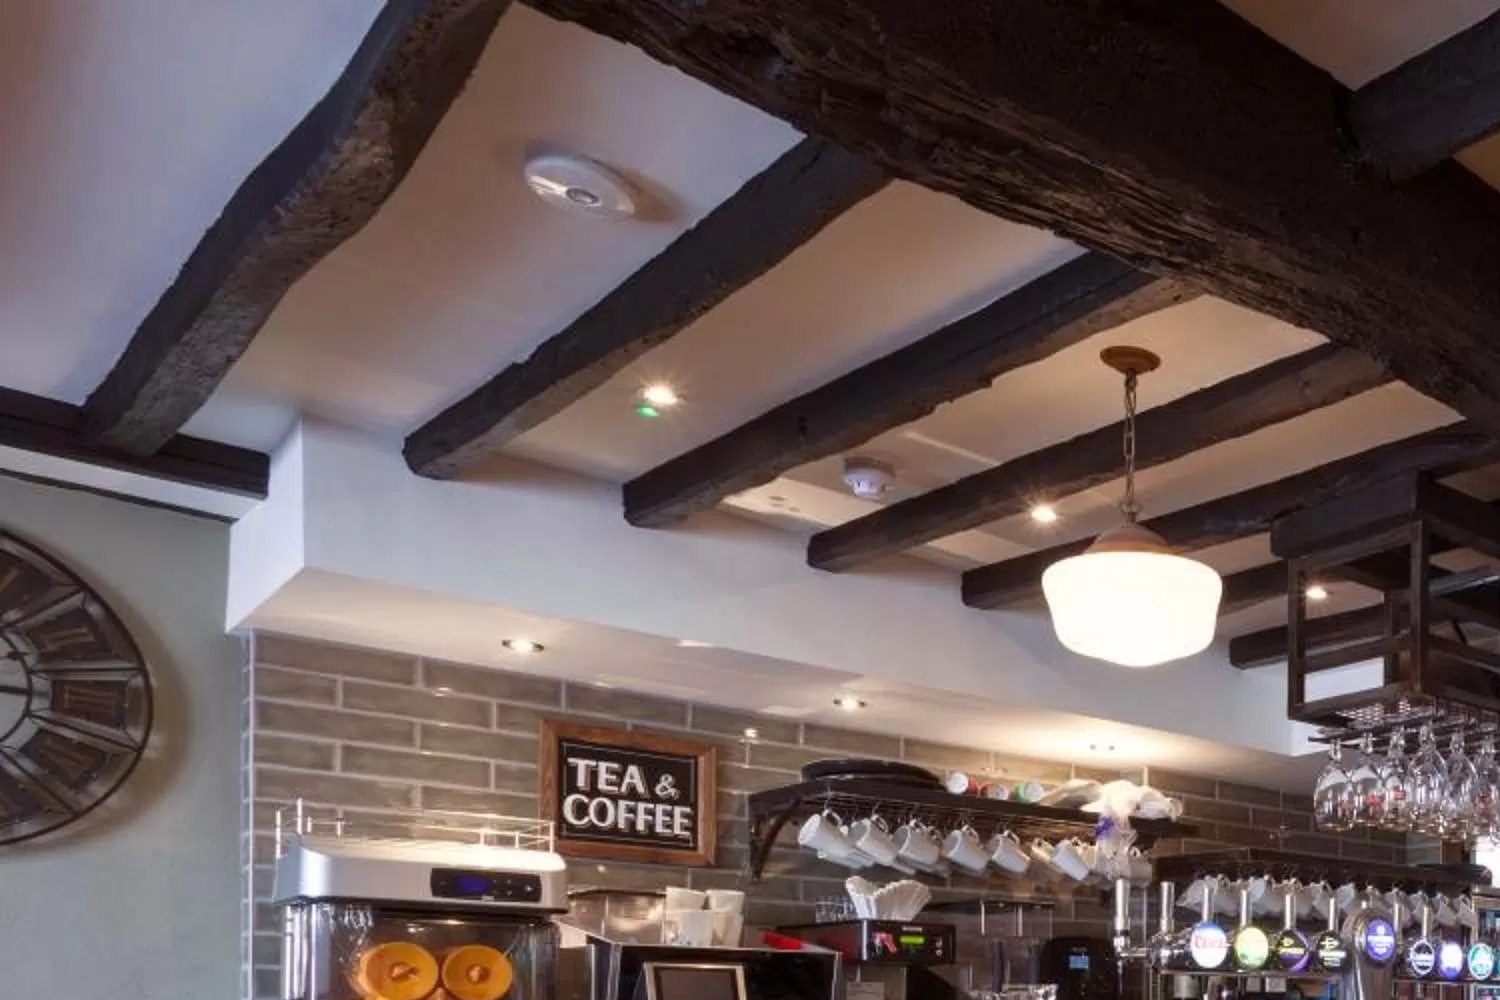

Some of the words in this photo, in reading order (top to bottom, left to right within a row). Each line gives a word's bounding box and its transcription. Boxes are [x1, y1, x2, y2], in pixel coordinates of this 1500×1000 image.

[567, 757, 649, 798] TEA
[654, 773, 679, 800] &
[562, 793, 693, 838] COFFEE
